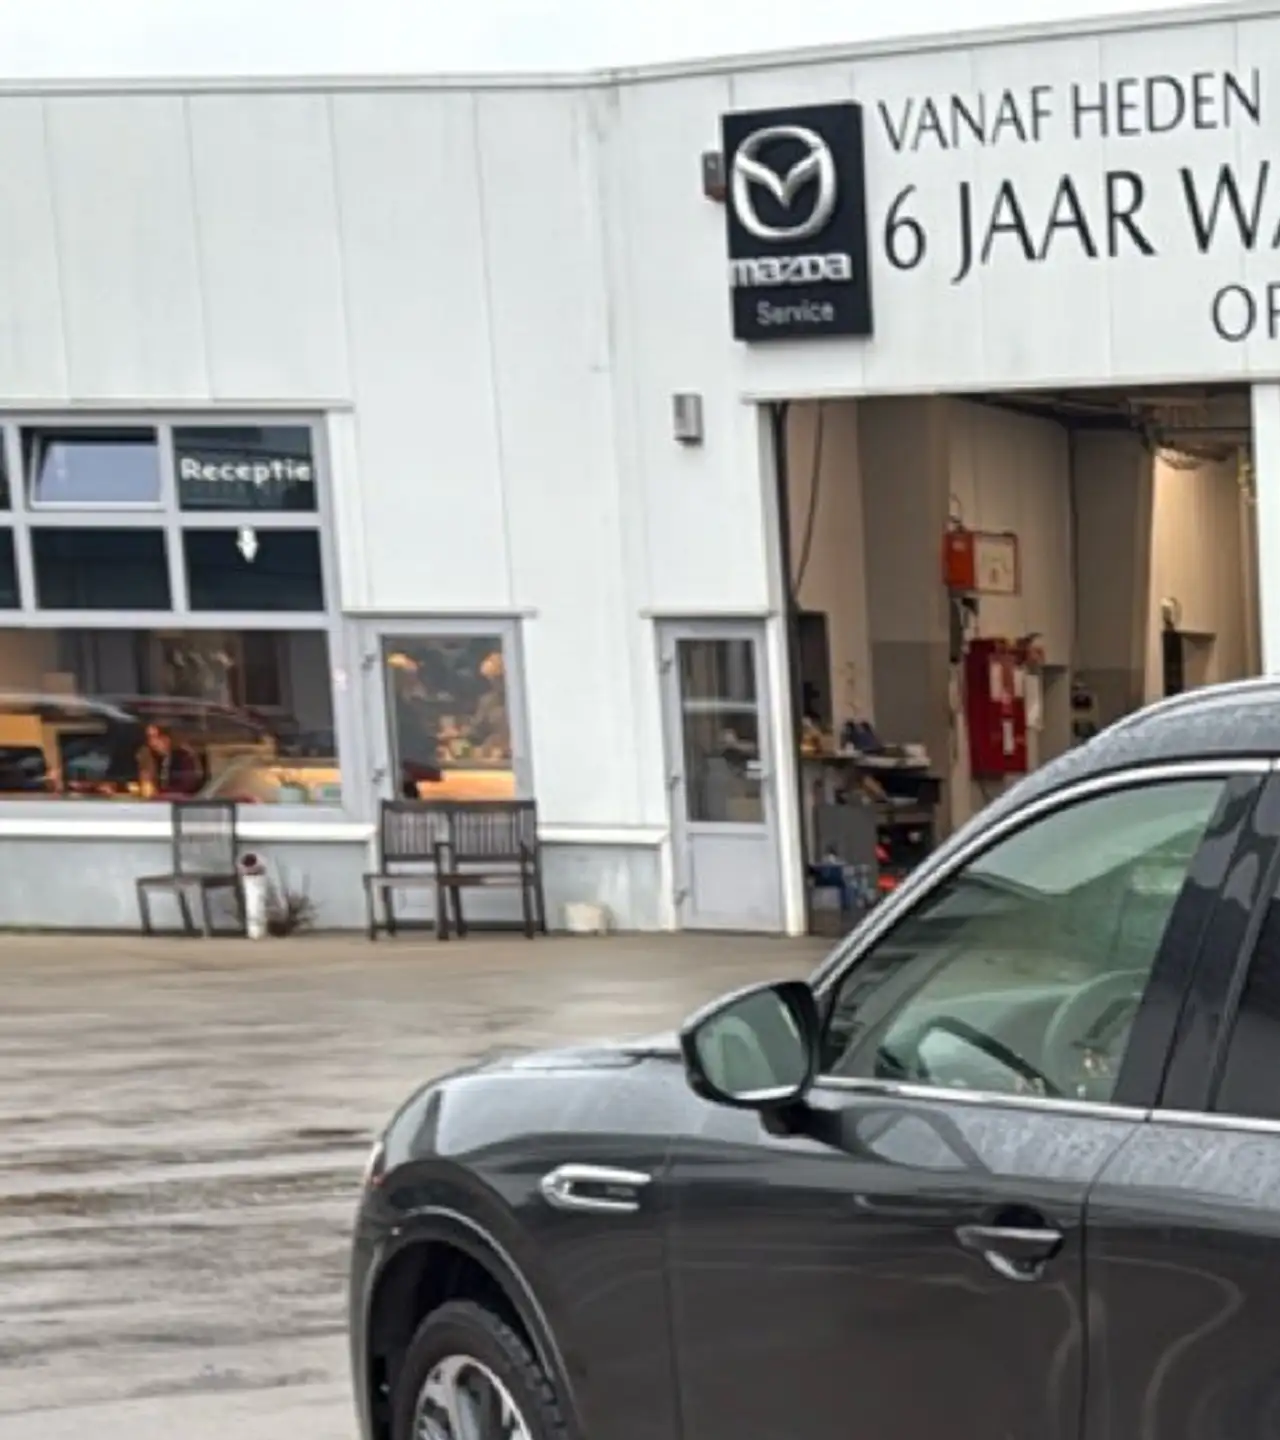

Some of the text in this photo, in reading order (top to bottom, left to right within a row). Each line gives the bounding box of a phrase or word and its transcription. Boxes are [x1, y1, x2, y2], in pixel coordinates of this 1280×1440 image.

[877, 67, 1262, 153] VANAF HEDEN
[884, 184, 926, 271] 6
[950, 170, 1157, 285] JAAR
[755, 299, 835, 326] Service
[180, 458, 311, 487] Receptie
